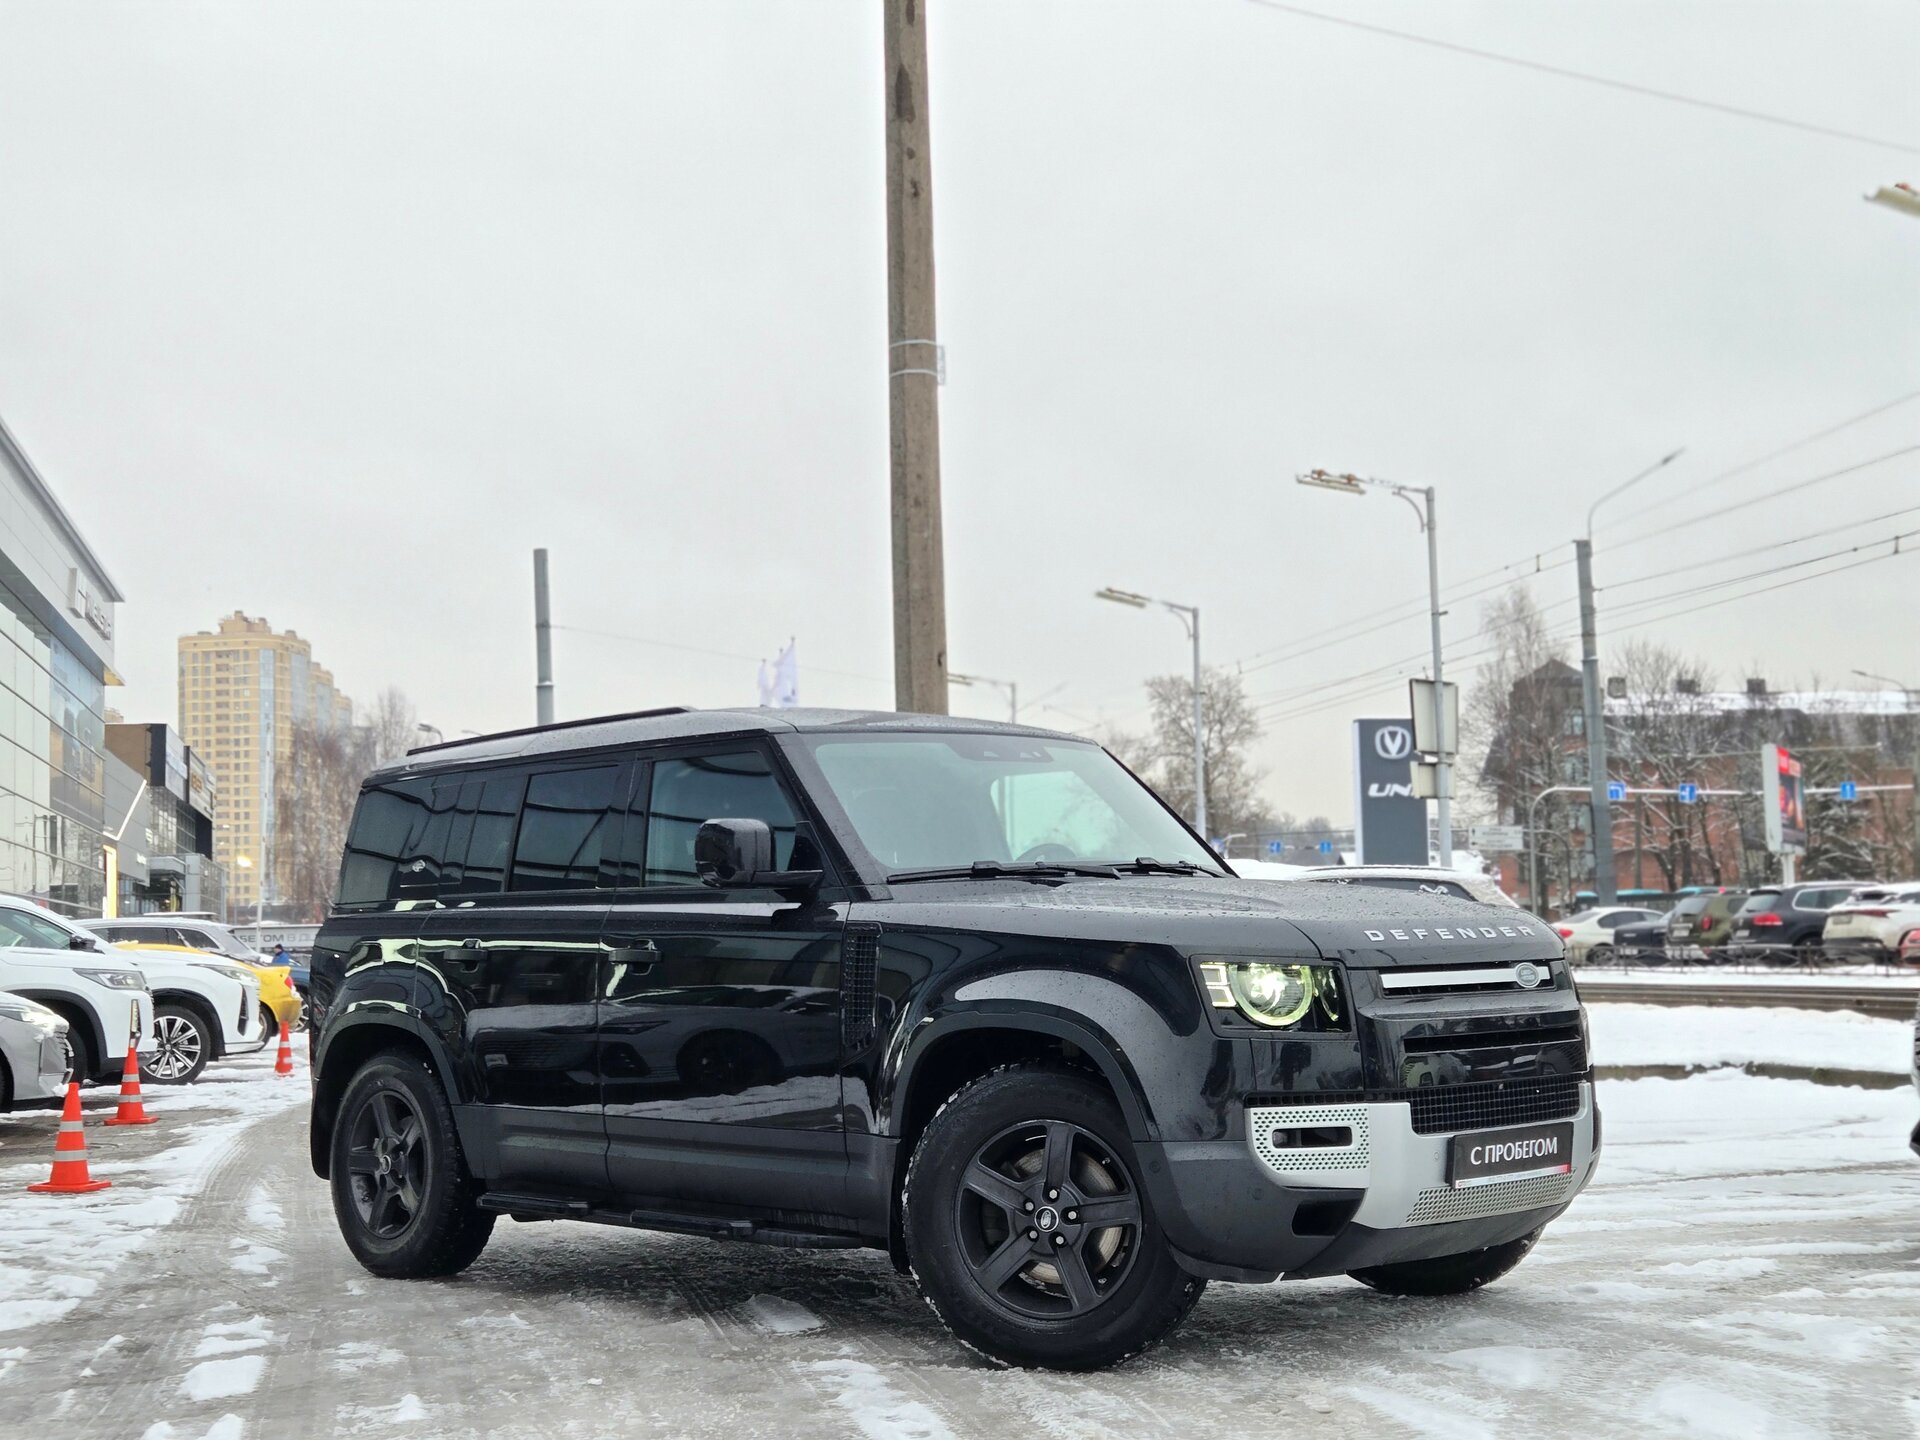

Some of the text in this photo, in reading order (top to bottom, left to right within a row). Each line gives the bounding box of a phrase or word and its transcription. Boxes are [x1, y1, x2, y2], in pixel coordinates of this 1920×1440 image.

[1364, 926, 1536, 942] DEFENDER
[1470, 1137, 1558, 1165] С ПРОБЕГОМ
